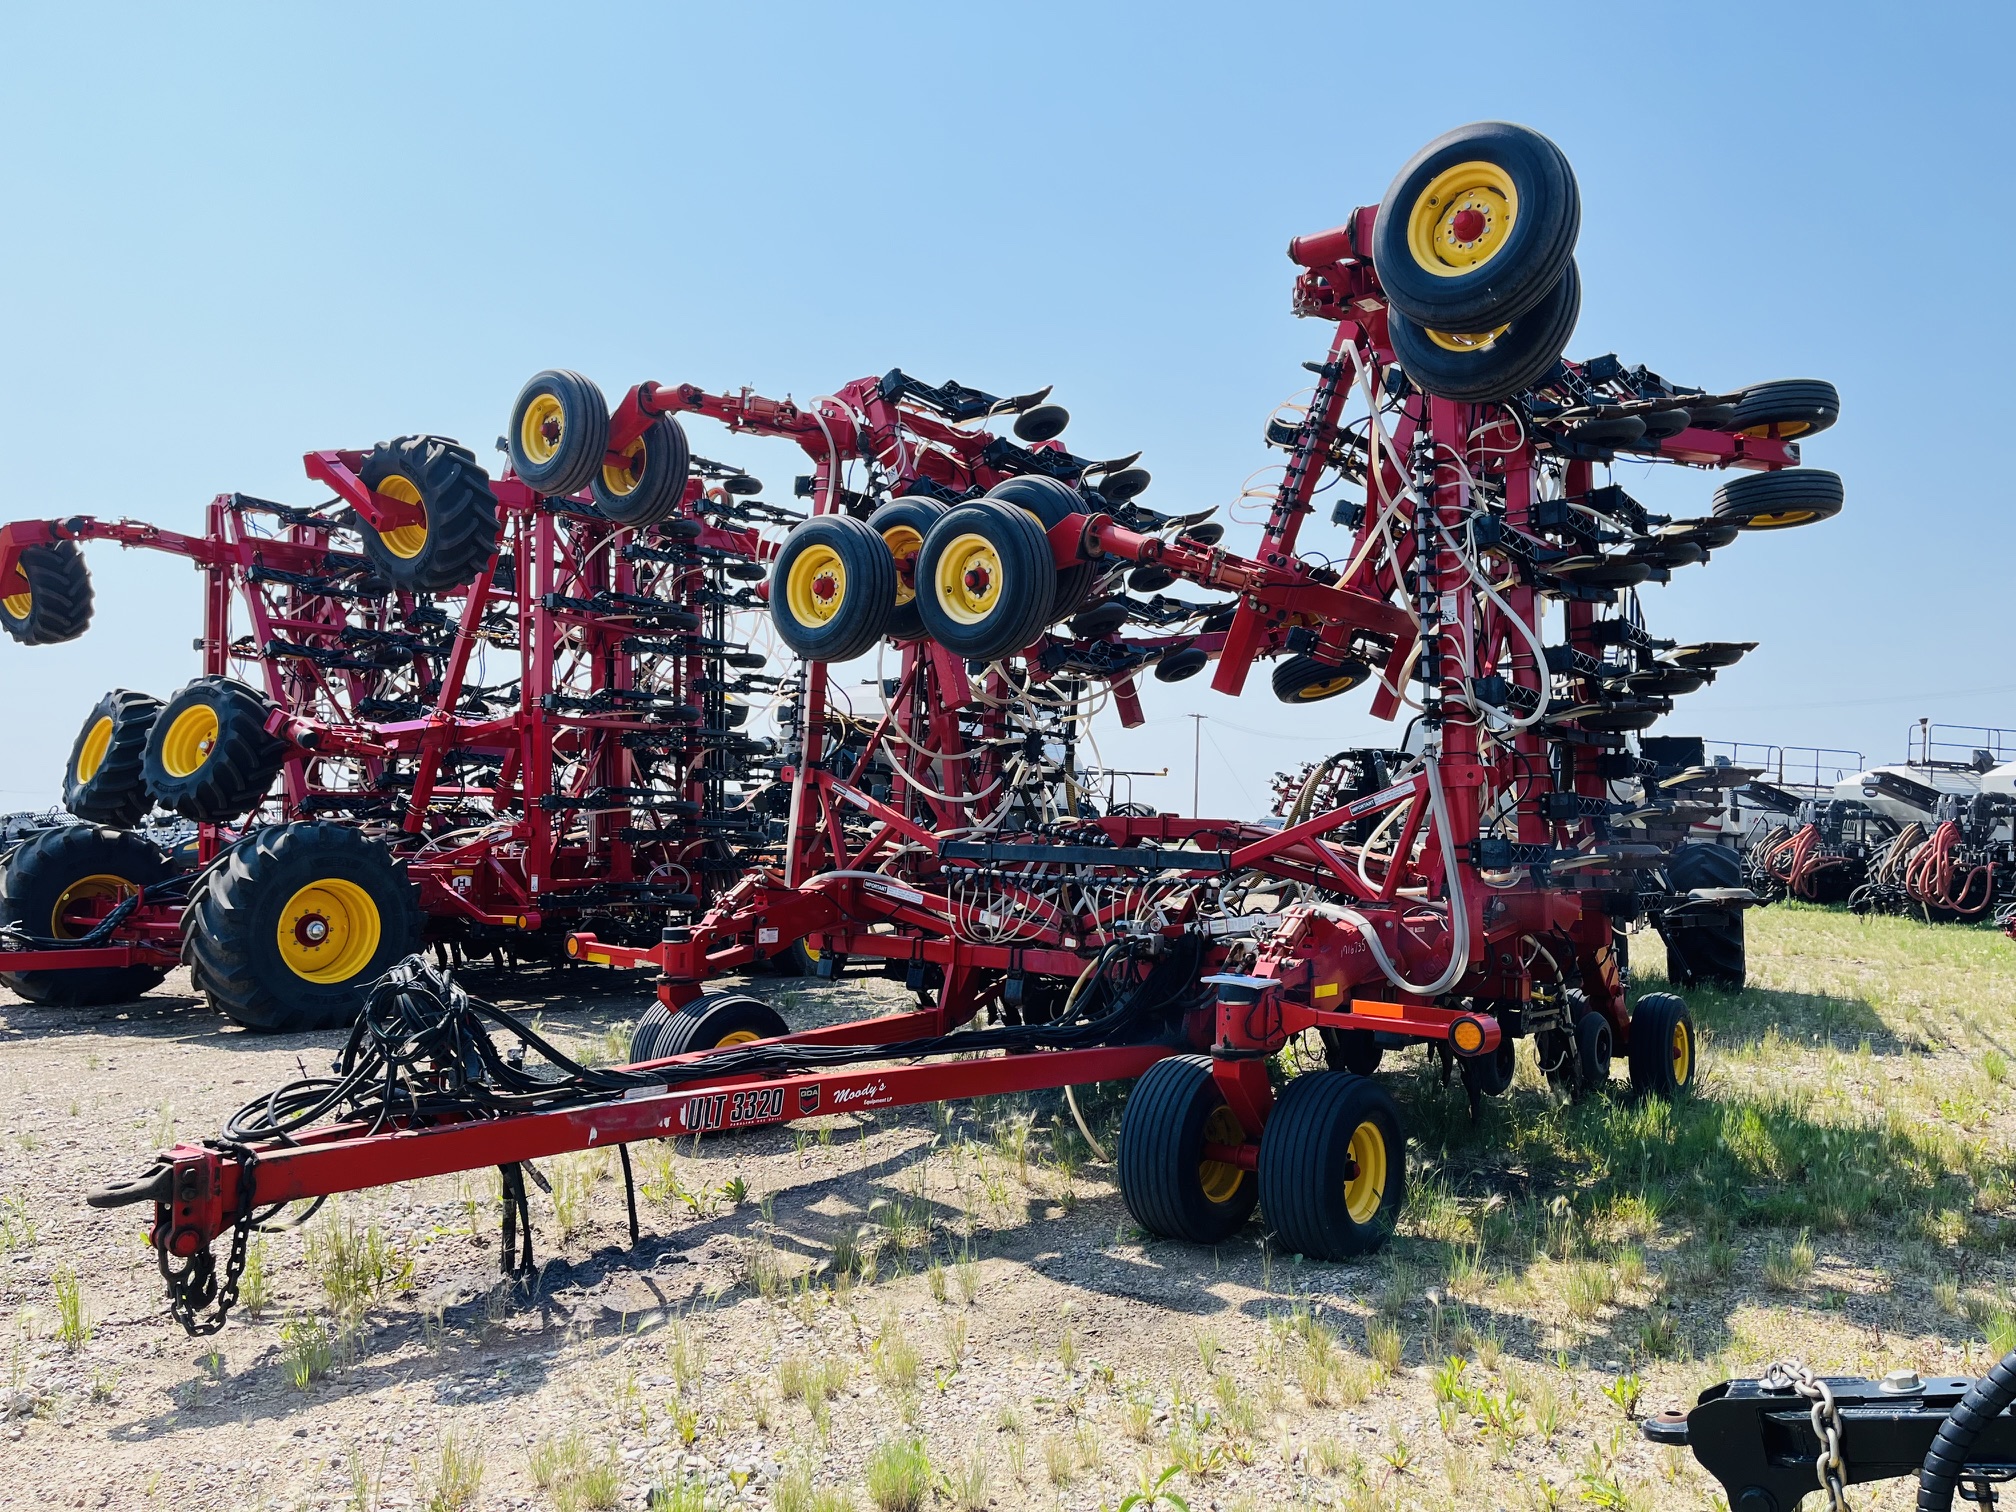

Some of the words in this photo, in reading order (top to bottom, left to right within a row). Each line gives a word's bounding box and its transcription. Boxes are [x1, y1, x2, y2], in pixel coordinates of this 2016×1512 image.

[865, 881, 887, 892] IMPORTANT
[833, 1078, 887, 1104] Moody's
[730, 1088, 785, 1122] 3320
[863, 1098, 887, 1106] Equipment
